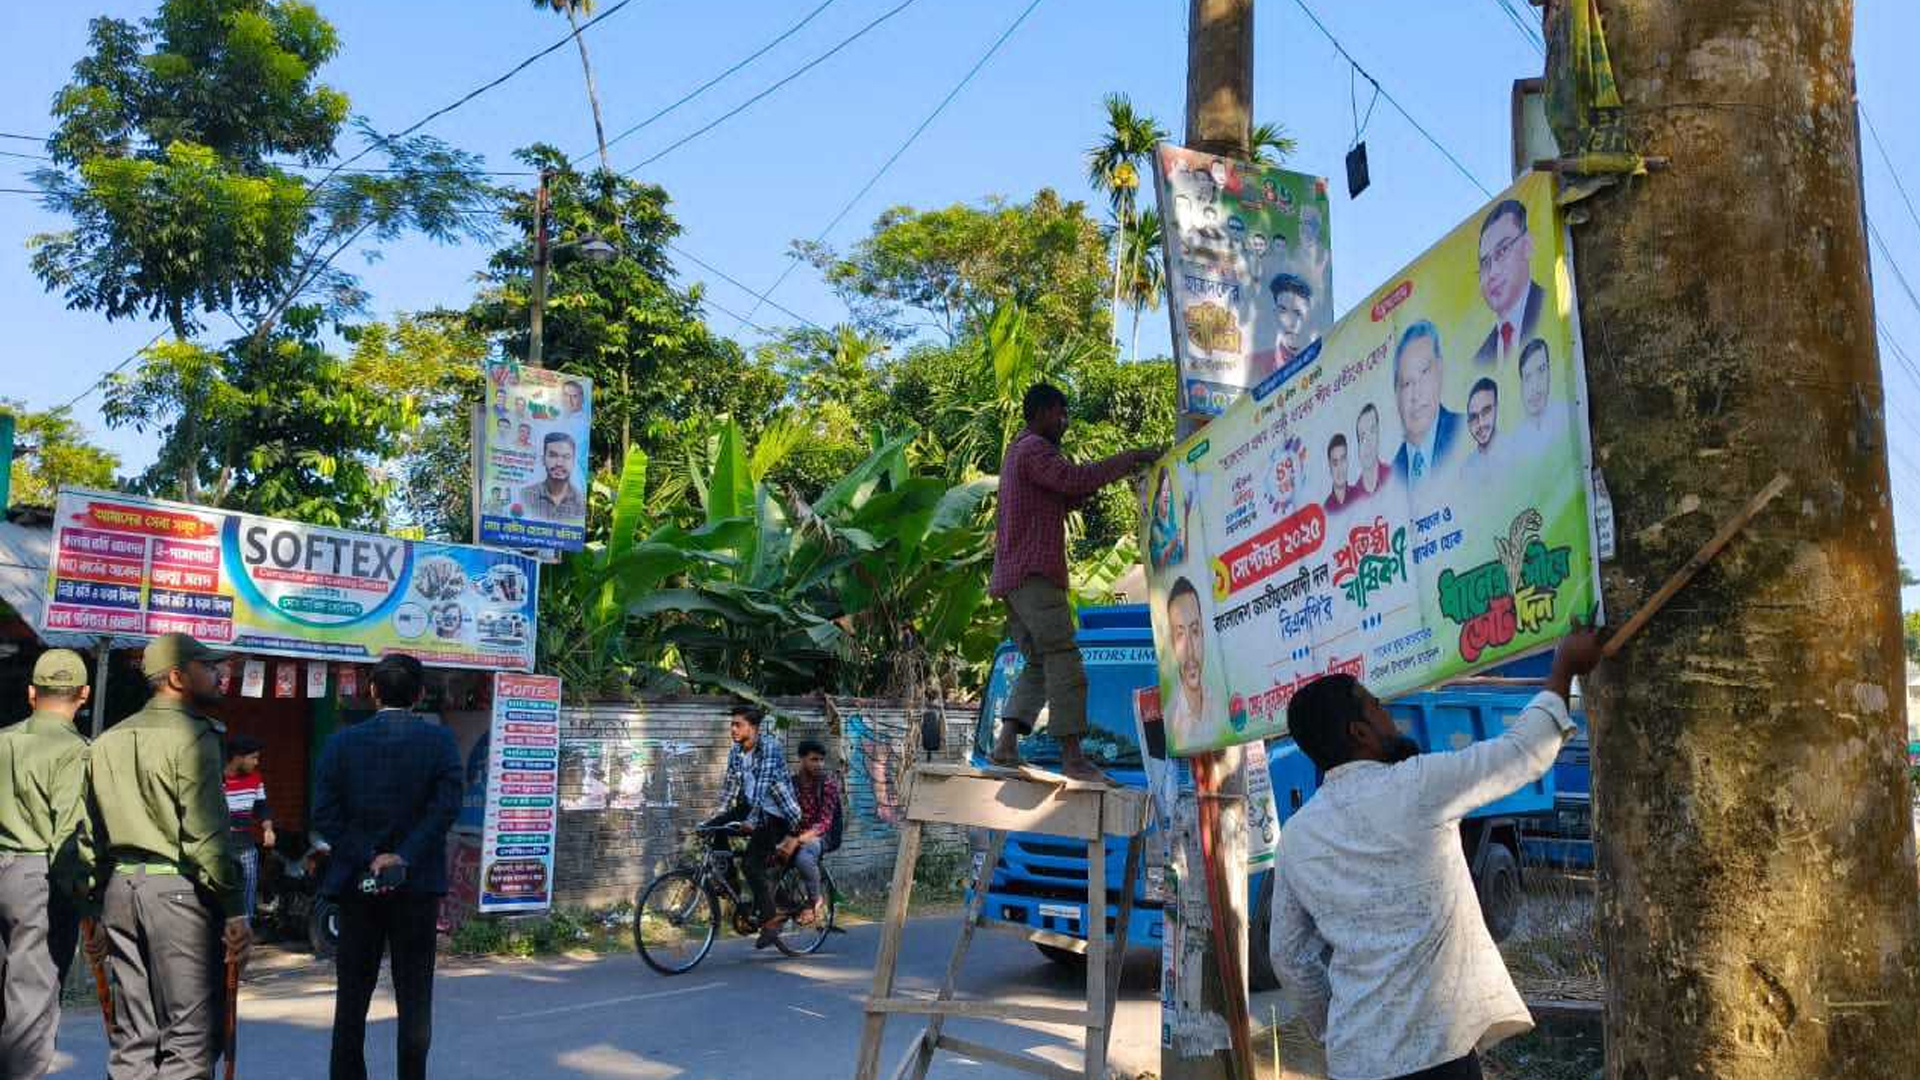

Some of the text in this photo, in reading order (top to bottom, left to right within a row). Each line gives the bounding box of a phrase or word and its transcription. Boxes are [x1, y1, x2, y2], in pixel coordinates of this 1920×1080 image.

[1283, 518, 1322, 555] ২০২৫
[1443, 506, 1453, 522] ও
[245, 525, 398, 582] SOFTEX
[1333, 515, 1389, 587] প্রতিষ্ঠা
[1340, 527, 1408, 610] বার্ষিকী
[1213, 563, 1330, 634] বাংলাদেশ জাতীয়তাবাদী দল
